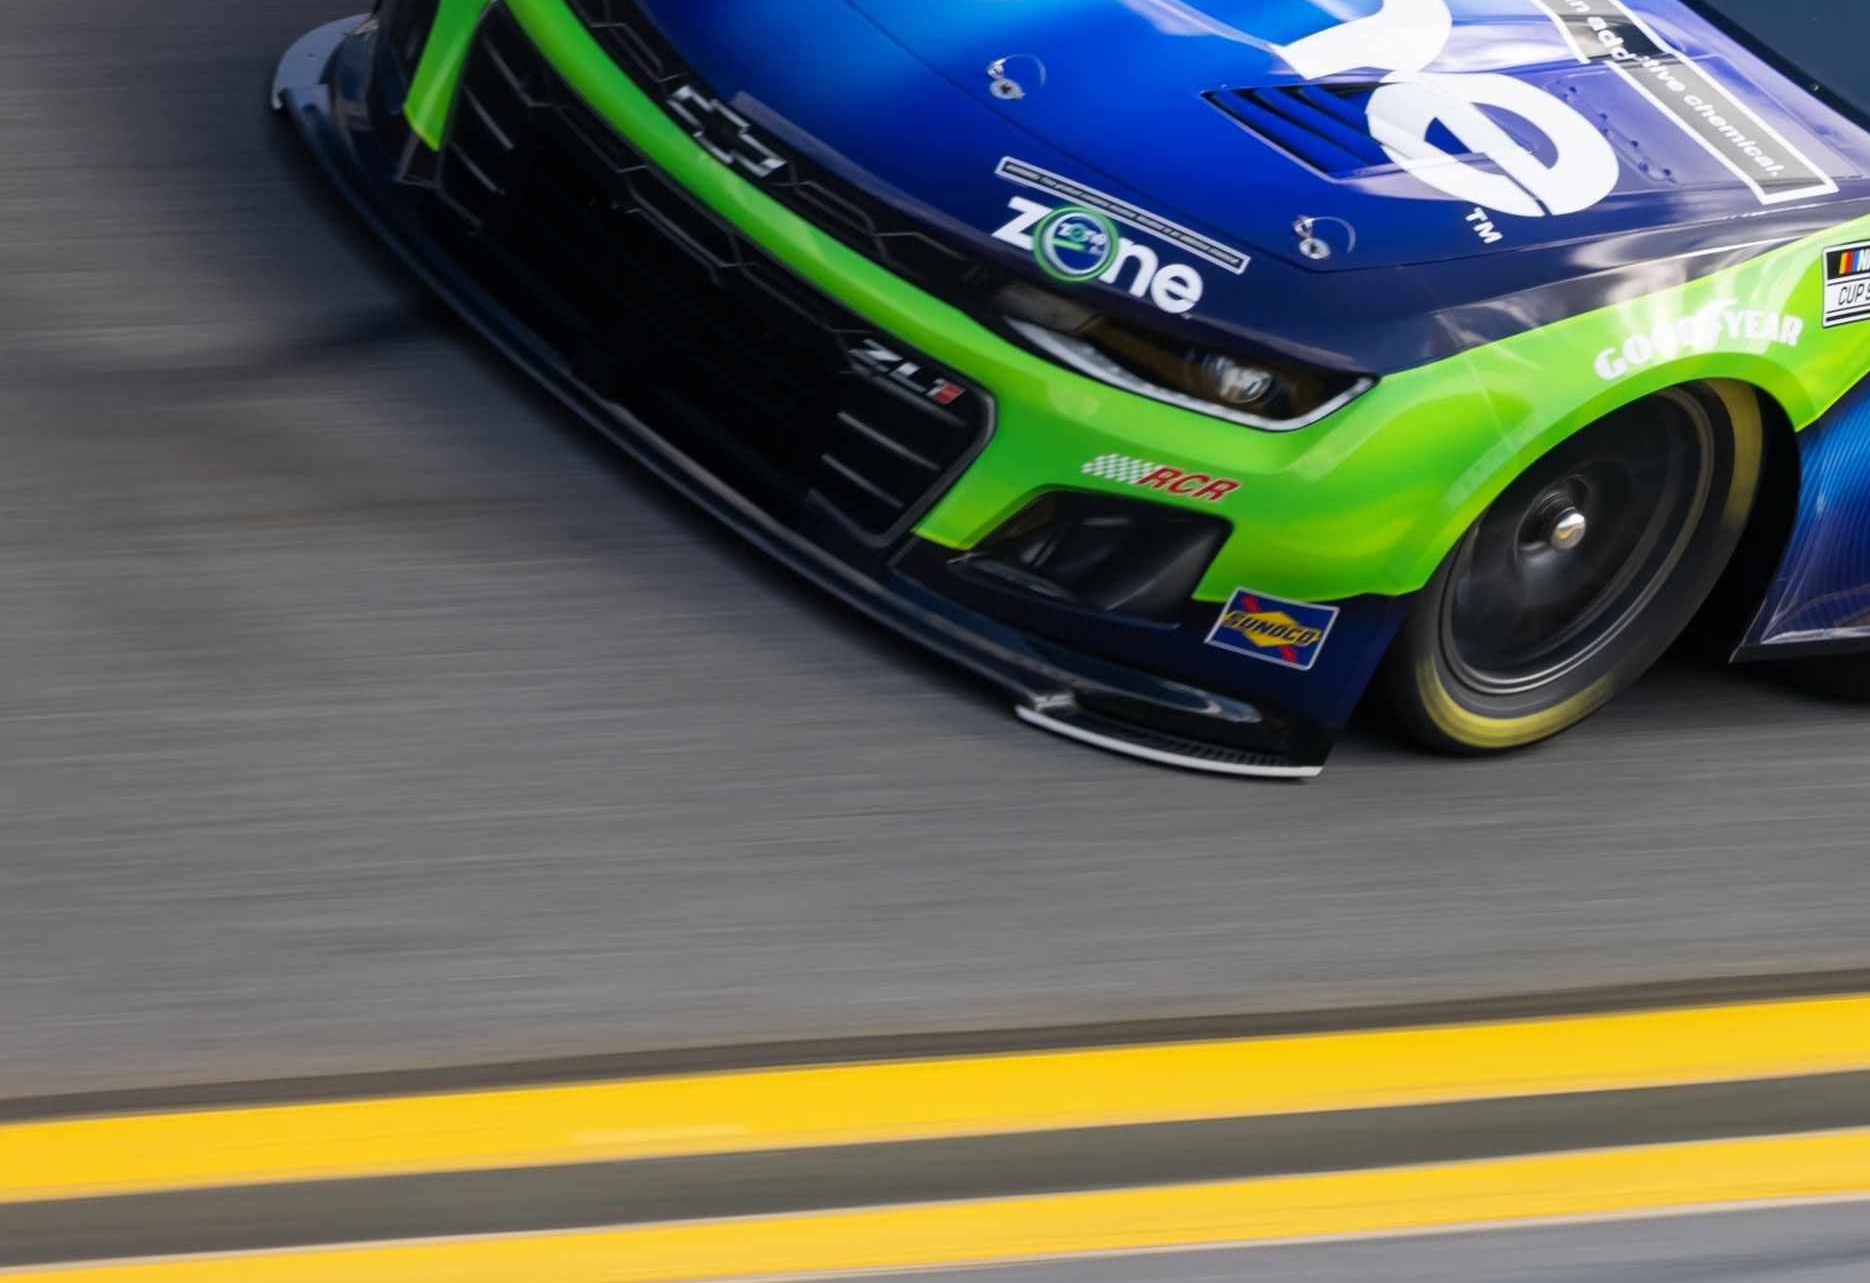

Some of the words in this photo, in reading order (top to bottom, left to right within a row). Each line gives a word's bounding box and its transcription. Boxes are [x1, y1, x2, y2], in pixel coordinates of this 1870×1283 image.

[1683, 94, 1788, 177] chemical.
[991, 195, 1204, 314] zone
[1837, 280, 1864, 305] CUP
[1136, 466, 1243, 503] RCR
[1220, 610, 1322, 647] SUNOCO
